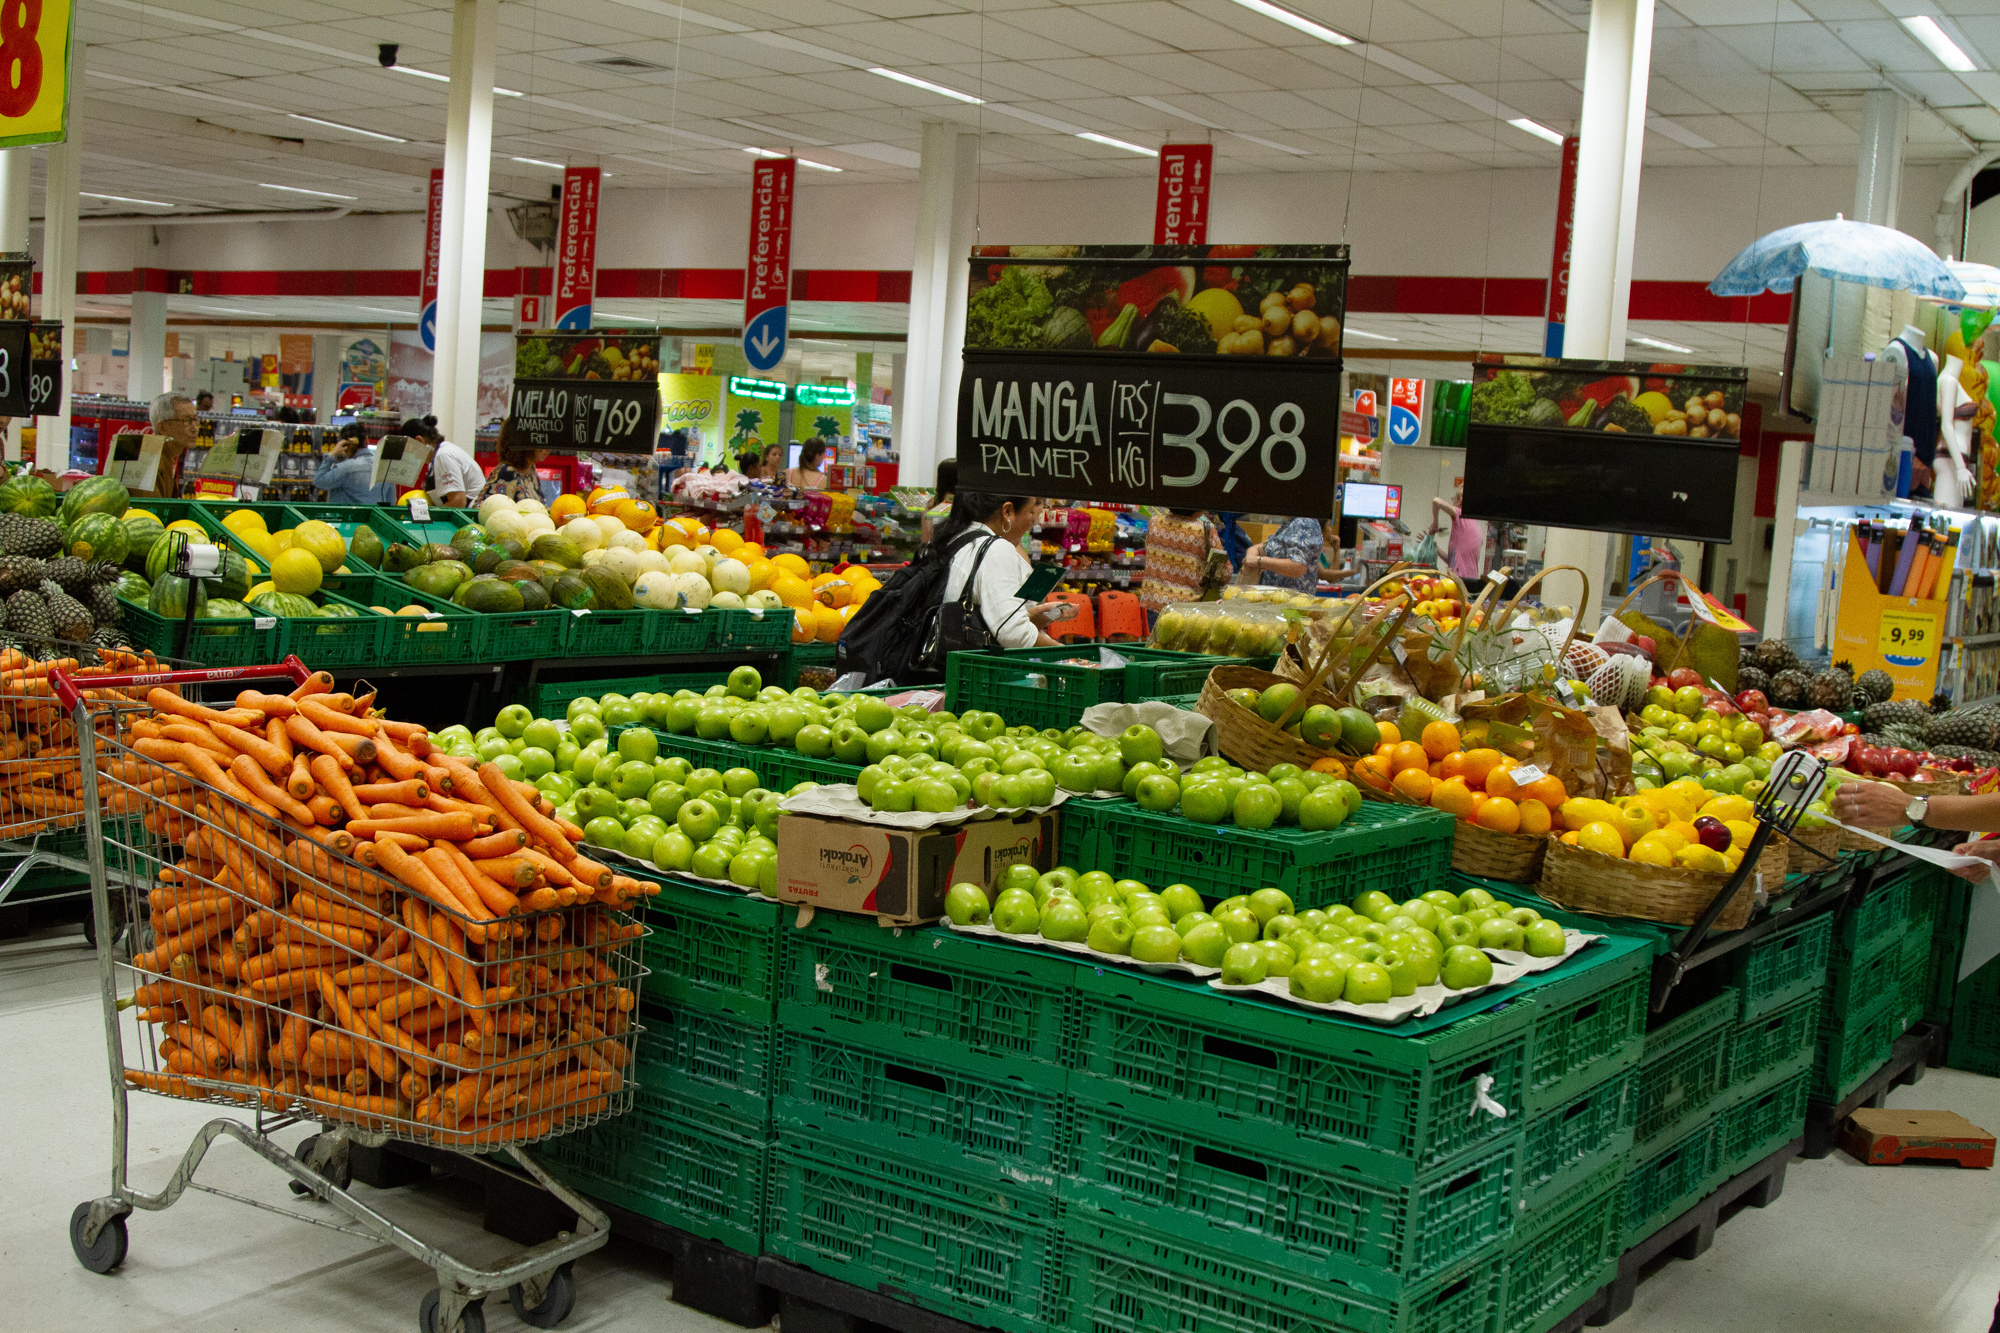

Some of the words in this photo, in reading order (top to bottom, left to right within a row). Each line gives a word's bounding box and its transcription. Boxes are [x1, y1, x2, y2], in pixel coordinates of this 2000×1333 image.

[426, 178, 444, 287] Preferencial
[560, 175, 582, 298] Preferencial
[751, 167, 773, 299] Preferencial
[972, 378, 1101, 446] MANGA
[1118, 380, 1152, 428] R$
[517, 418, 564, 432] AMARELO
[530, 432, 549, 444] REI
[593, 399, 641, 445] 7,69
[1160, 392, 1306, 493] 3,98
[979, 443, 1093, 486] PALMER
[1117, 442, 1146, 488] KG
[1891, 627, 1925, 646] 9,99
[132, 674, 162, 685] extra
[206, 667, 234, 680] extra
[819, 848, 869, 869] Arakaki
[819, 862, 859, 873] HORTIFRUTI
[994, 845, 1030, 863] Arakaki
[788, 886, 819, 897] FRUTAS
